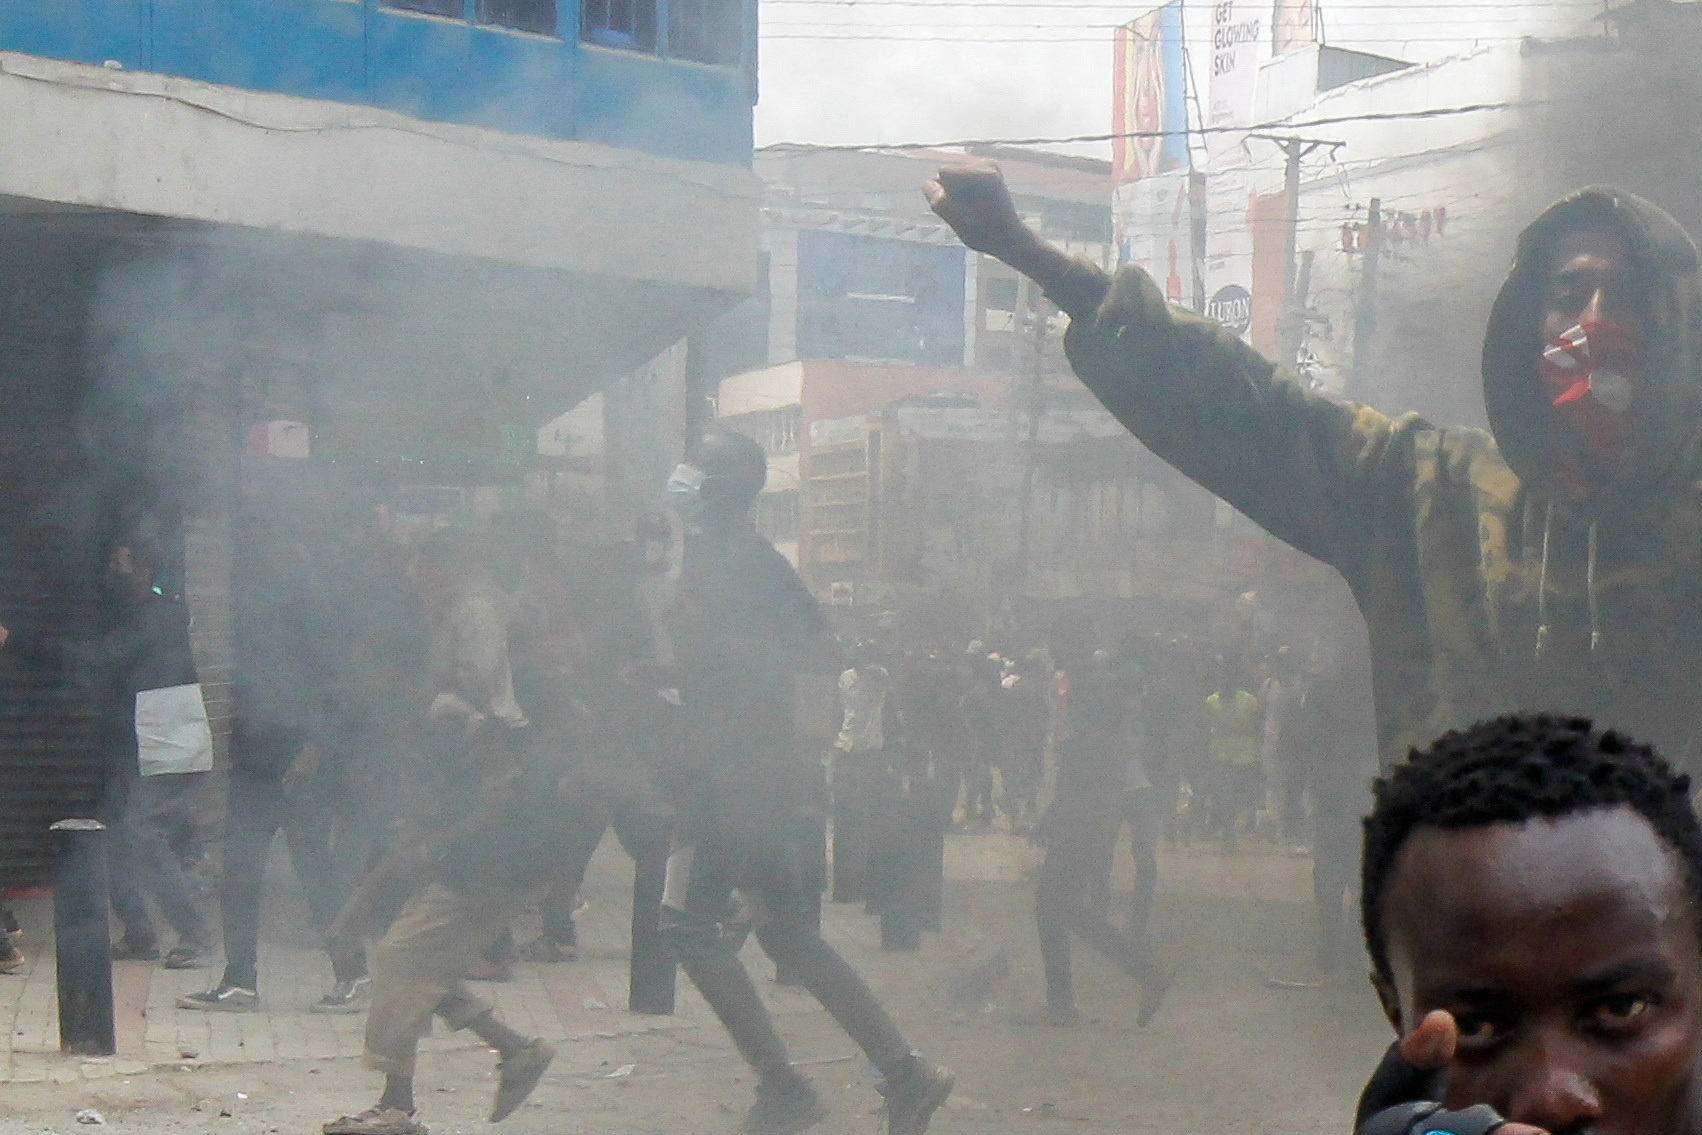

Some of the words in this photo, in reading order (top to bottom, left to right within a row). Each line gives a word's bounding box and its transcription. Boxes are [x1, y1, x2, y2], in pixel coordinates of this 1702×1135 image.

[1215, 0, 1234, 24] GET
[1214, 19, 1259, 50] GLOWING
[1214, 49, 1236, 77] SKIN
